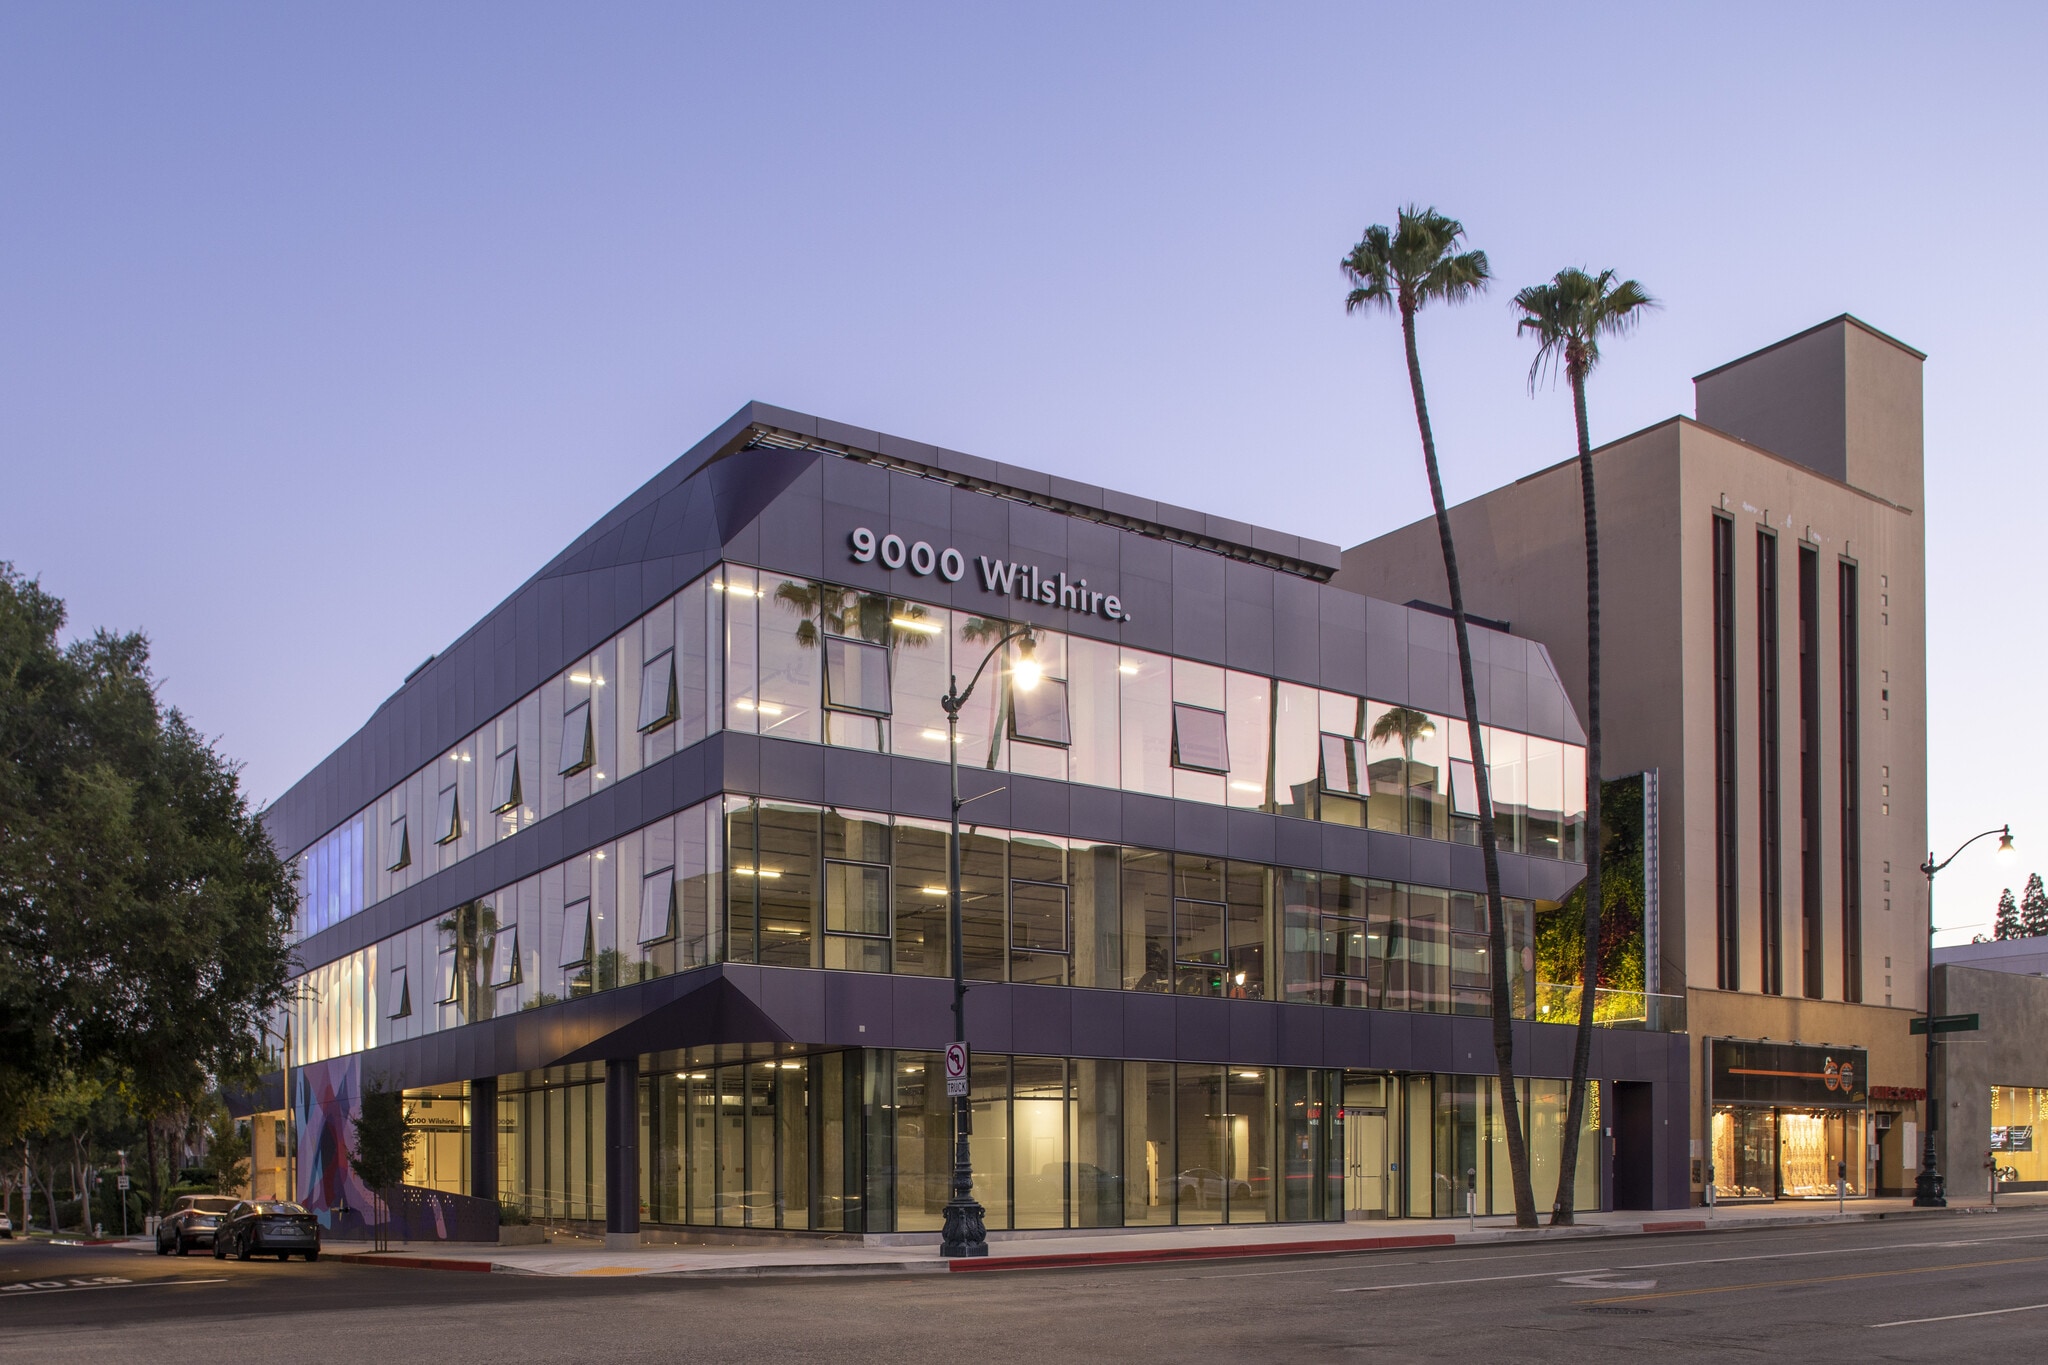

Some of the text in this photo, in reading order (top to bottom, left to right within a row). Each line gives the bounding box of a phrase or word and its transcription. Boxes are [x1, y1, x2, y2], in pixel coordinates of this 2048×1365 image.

[852, 527, 1131, 622] 9000 Wilshire.
[948, 1082, 966, 1093] TRUCK
[0, 1276, 133, 1291] STOP
